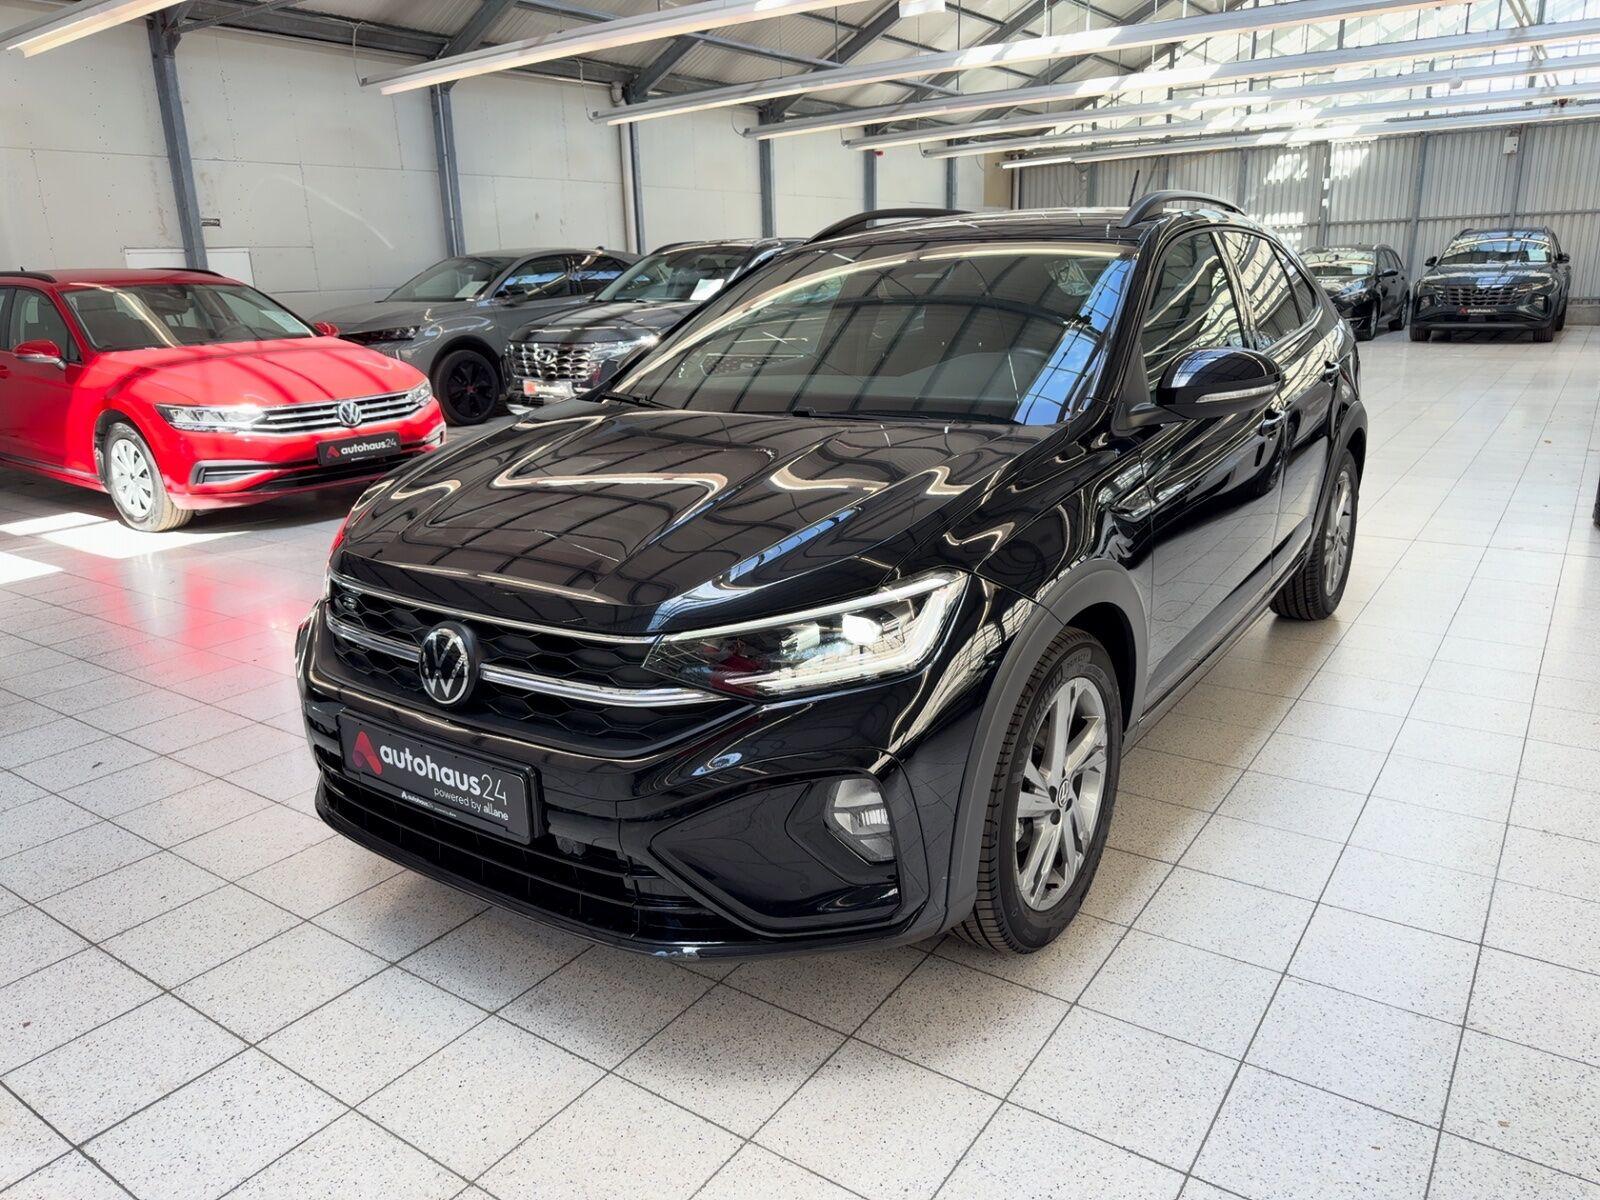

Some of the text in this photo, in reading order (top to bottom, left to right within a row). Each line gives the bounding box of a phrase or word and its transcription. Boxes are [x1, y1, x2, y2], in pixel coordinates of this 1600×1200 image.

[341, 438, 397, 455] autohaus24
[379, 744, 507, 806] autohaus24
[433, 787, 470, 807] powered
[471, 798, 481, 813] by
